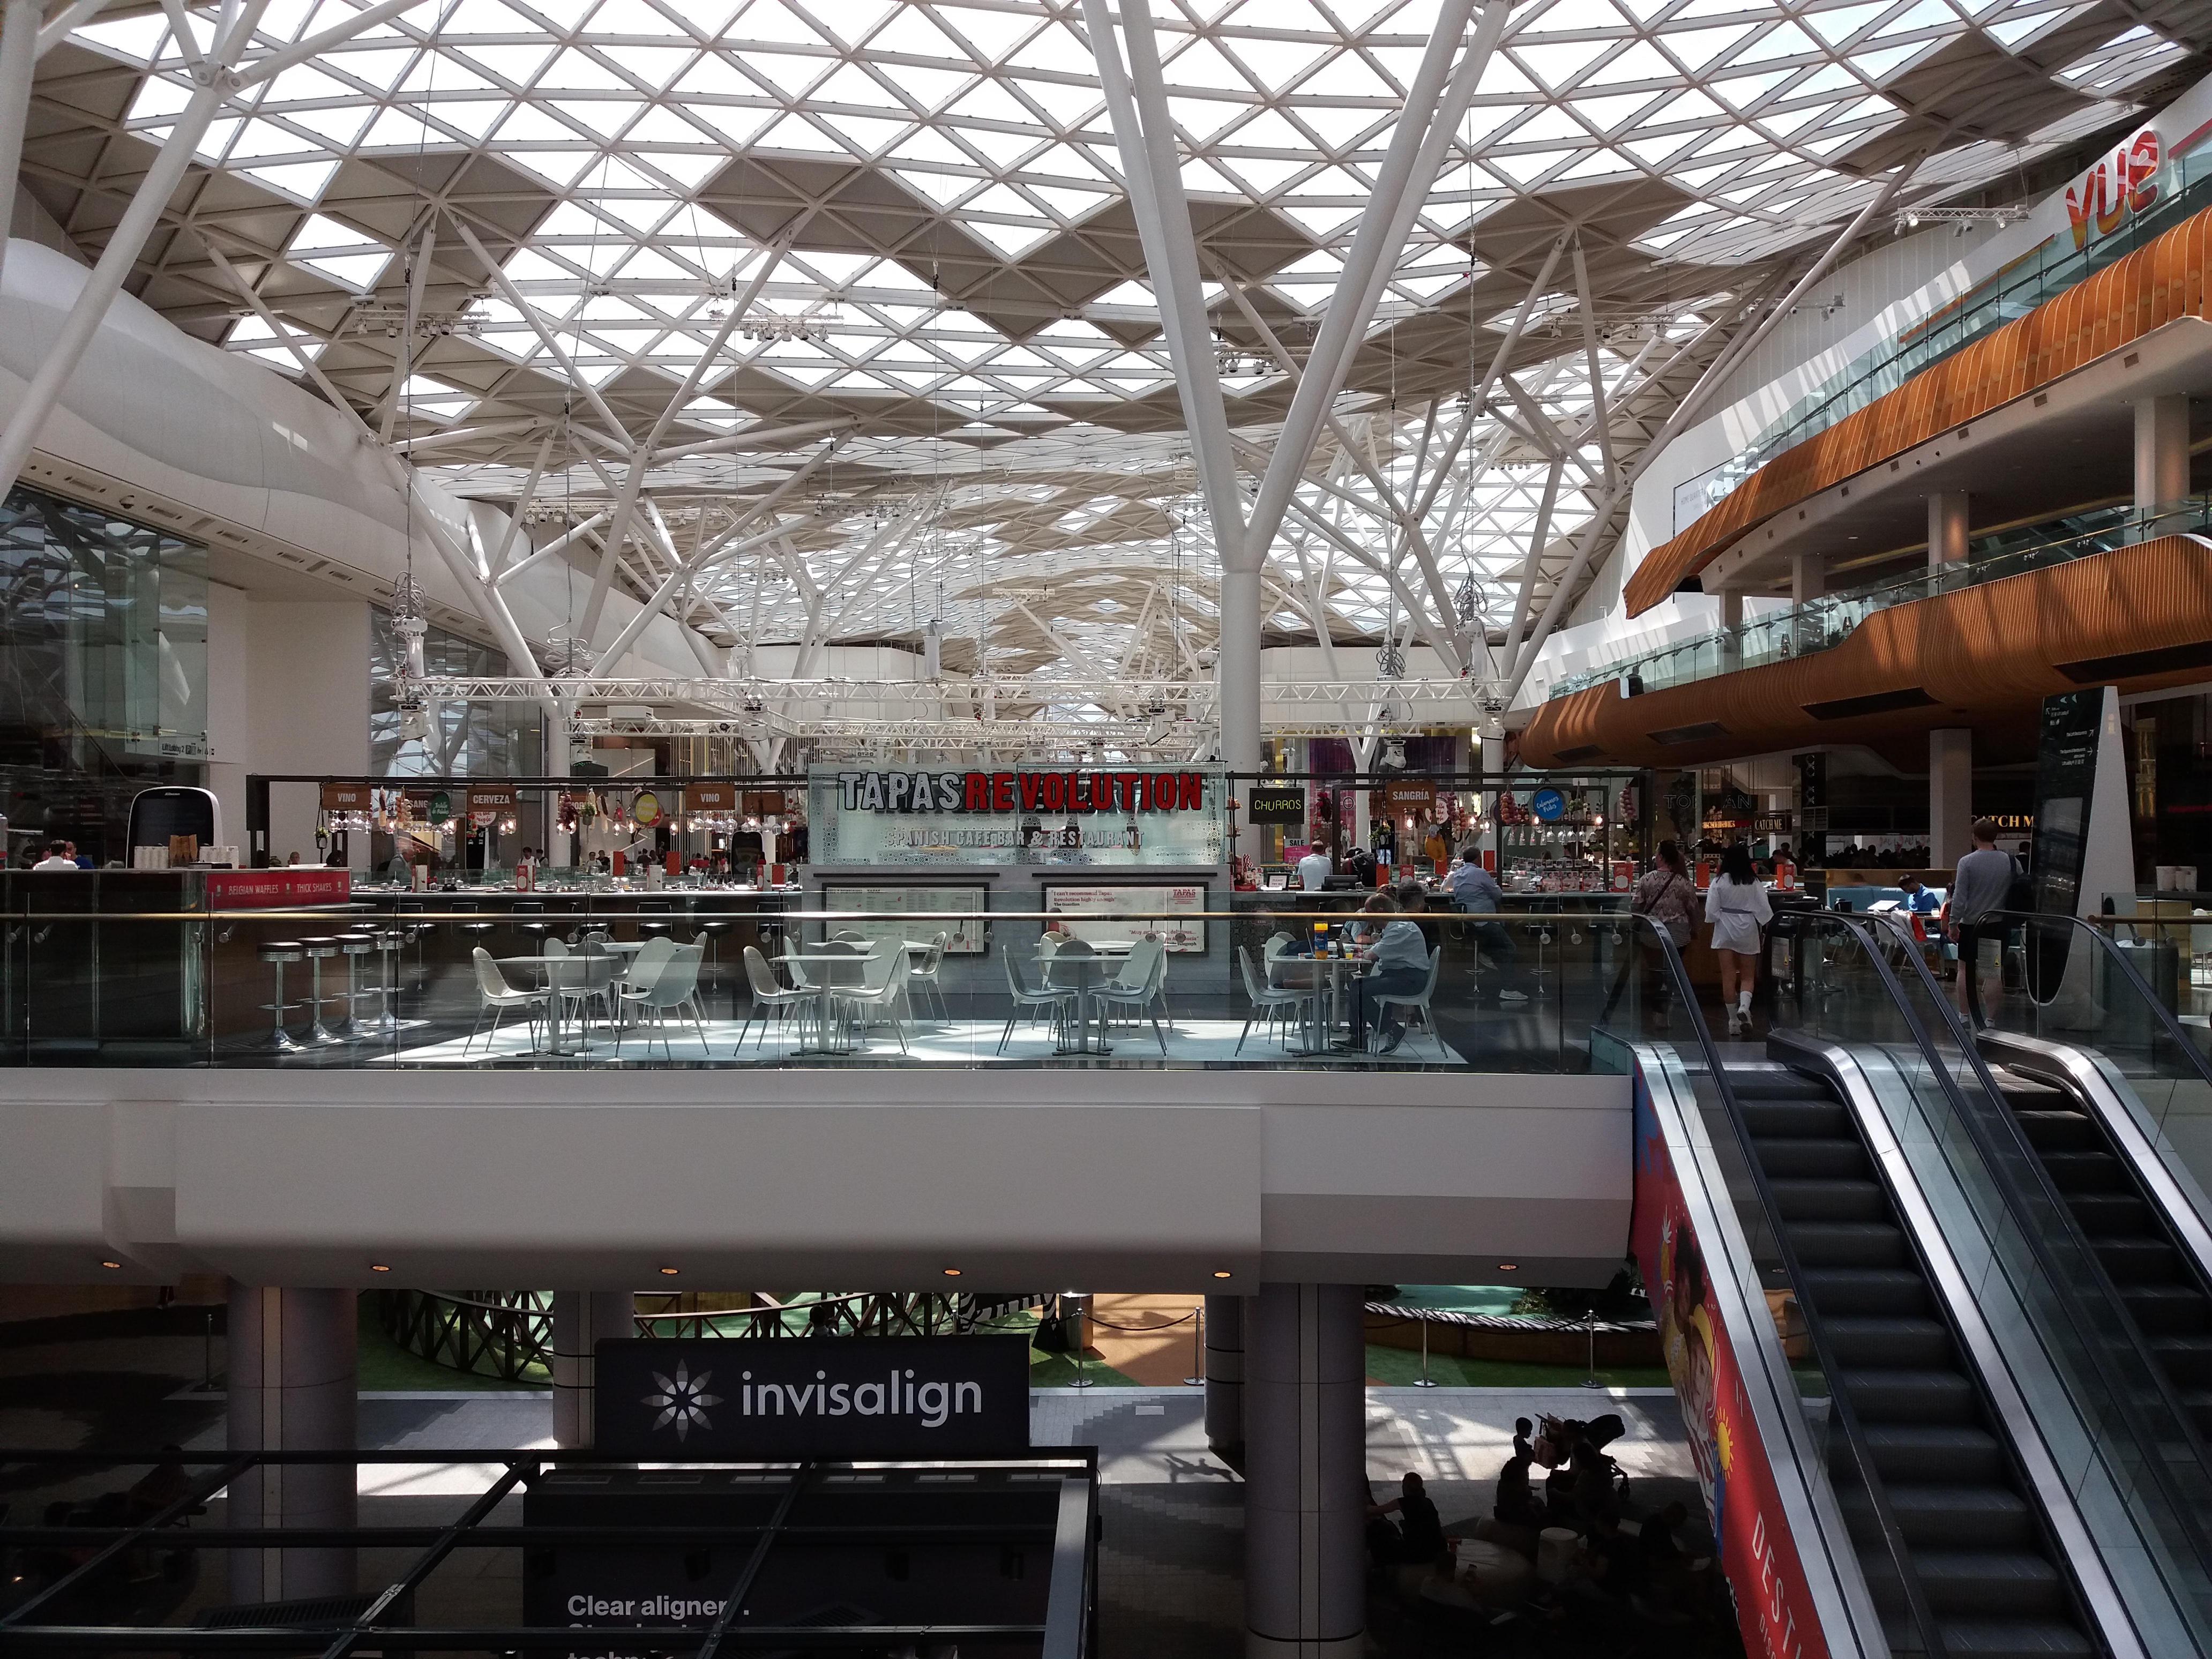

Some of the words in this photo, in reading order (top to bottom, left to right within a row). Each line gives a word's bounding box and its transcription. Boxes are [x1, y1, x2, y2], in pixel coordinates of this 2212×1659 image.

[338, 793, 356, 802] VINO
[473, 795, 510, 804] CERVEZA
[700, 793, 720, 802] VINO
[1392, 788, 1430, 800] SANGRÍA
[409, 799, 428, 808] SANG
[1254, 799, 1302, 811] CHURROS
[1664, 795, 1752, 809] TOAN
[1755, 819, 1774, 831] CATCH
[1774, 818, 1783, 830] ME
[887, 831, 950, 846] SPANISH
[997, 831, 1025, 846] BAR
[1030, 831, 1044, 846] &
[1050, 831, 1145, 846] RESTAURANT
[228, 885, 254, 895] BELGIAN
[255, 884, 279, 894] WAFFLES
[297, 884, 311, 893] THICK
[312, 883, 332, 892] SHAKES
[742, 1369, 982, 1428] invisalign
[567, 1594, 636, 1617] Clear
[640, 1595, 750, 1620] aligner.
